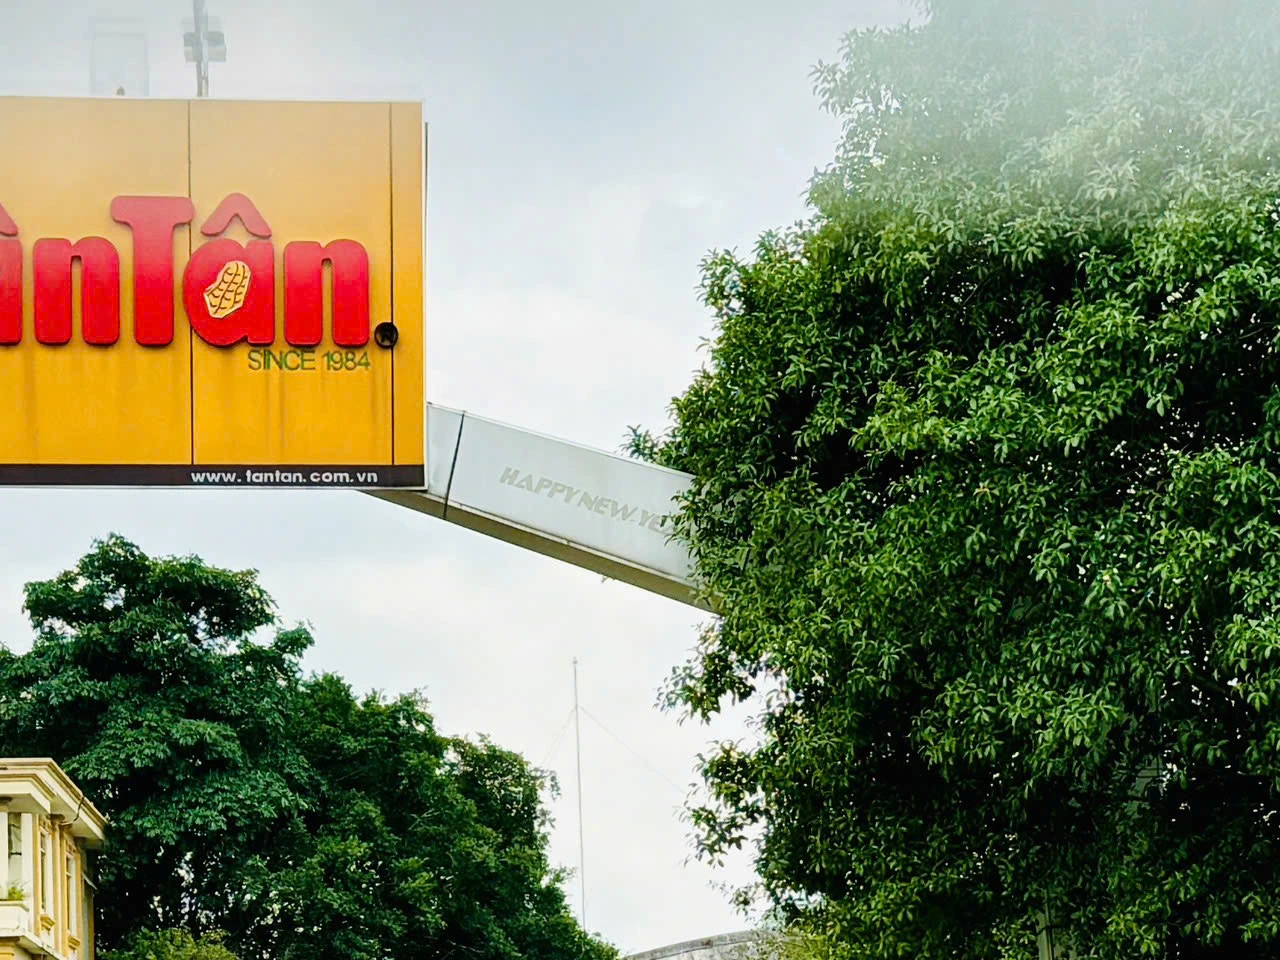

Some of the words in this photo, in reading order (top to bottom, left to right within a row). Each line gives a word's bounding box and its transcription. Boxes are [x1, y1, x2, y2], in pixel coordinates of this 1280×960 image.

[247, 350, 316, 371] SINCE
[322, 350, 370, 371] 1984
[499, 465, 579, 504] HAPPY
[577, 491, 638, 521] NEW
